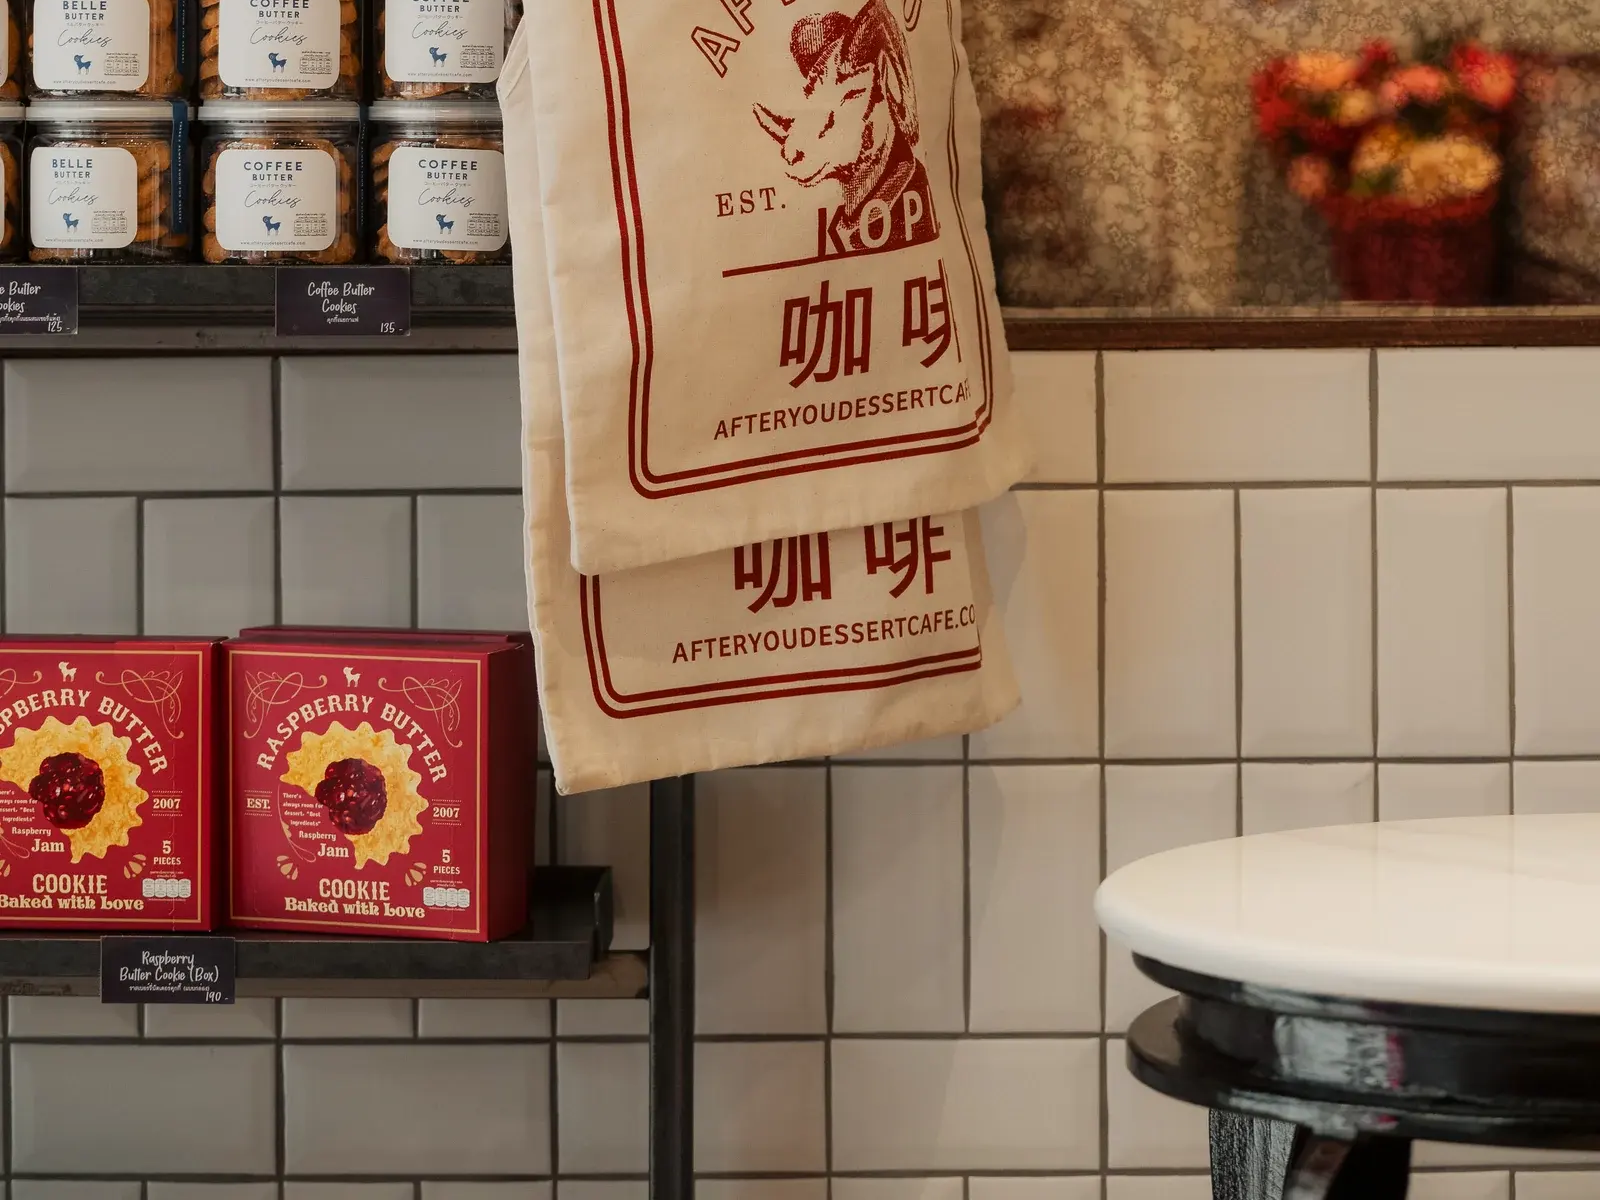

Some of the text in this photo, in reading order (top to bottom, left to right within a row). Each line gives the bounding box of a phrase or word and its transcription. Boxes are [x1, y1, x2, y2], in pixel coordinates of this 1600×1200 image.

[63, 1, 107, 10] BELLE
[419, 4, 460, 13] BUTTER
[65, 13, 104, 21] BUTTER
[258, 10, 300, 19] BUTTER
[58, 28, 112, 47] Cookies
[250, 26, 307, 45] Cookies
[411, 20, 468, 40] Cookies
[52, 159, 93, 169] BELLE
[244, 161, 303, 171] COFFEE
[418, 159, 478, 171] COFFEE
[54, 171, 90, 179] BUTTER
[252, 173, 293, 181] BUTTER
[427, 172, 468, 181] BUTTER
[49, 187, 98, 205] Cookies
[244, 189, 301, 208] Cookies
[418, 188, 476, 207] Cookies
[715, 187, 786, 217] EST.
[9, 280, 41, 295] Butter
[307, 282, 375, 298] Coffee Butter
[0, 297, 26, 313] ookies
[322, 298, 357, 314] Cookies
[97, 696, 168, 775] BUTTER
[257, 693, 447, 783] RASPBERRY BUTTER
[153, 798, 181, 809] 2007
[246, 797, 271, 810] EST.
[432, 807, 460, 819] 2007
[12, 826, 52, 837] Raspberry
[299, 830, 336, 842] Raspberry
[31, 838, 65, 853] Jam
[162, 839, 172, 855] 5
[317, 843, 349, 858] Jam
[153, 856, 182, 866] PIECES
[442, 849, 451, 863] 5
[433, 864, 461, 875] PIECES
[32, 873, 108, 894] COOKIE
[319, 877, 390, 901] COOKIE
[57, 895, 96, 910] with
[100, 895, 144, 910] Love
[284, 896, 426, 918] Baked with Love
[142, 950, 195, 969] Raspberry
[120, 965, 219, 983] Butter Cookie (Box)
